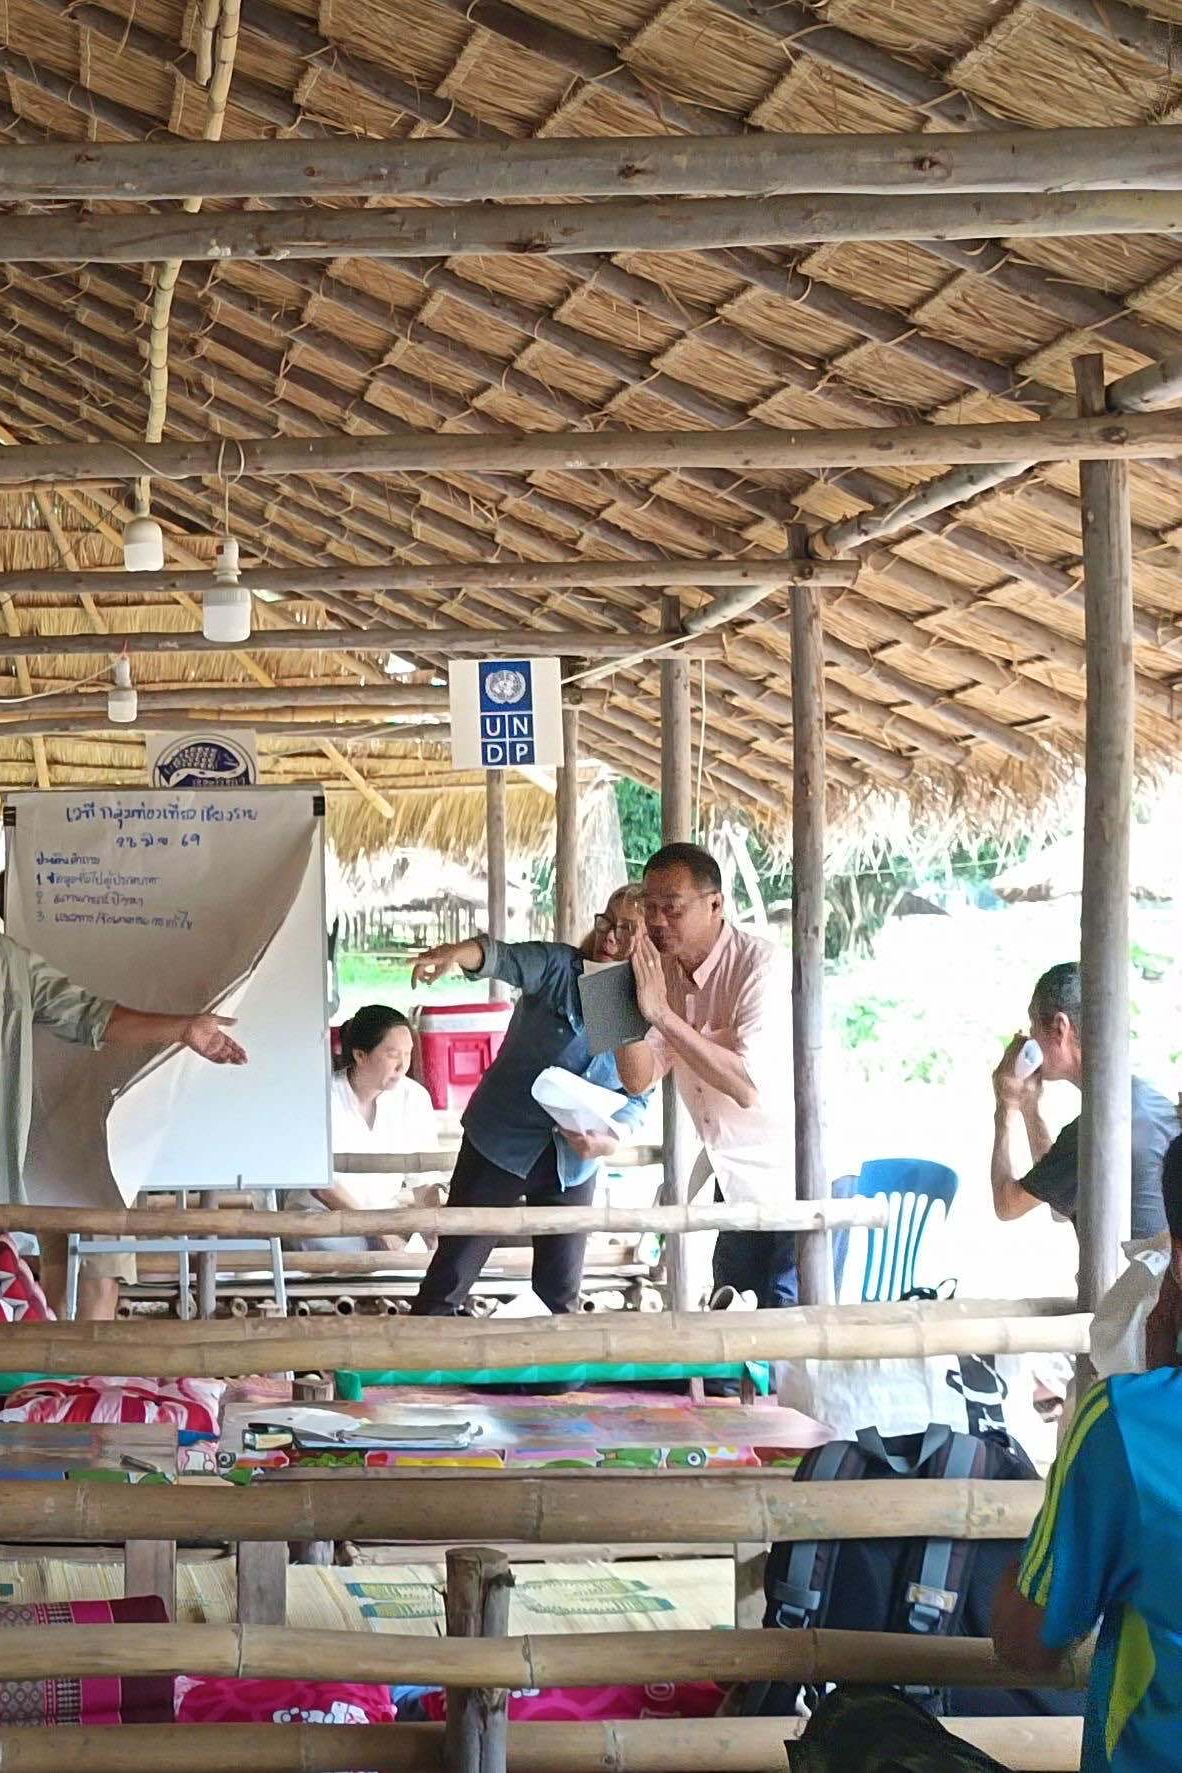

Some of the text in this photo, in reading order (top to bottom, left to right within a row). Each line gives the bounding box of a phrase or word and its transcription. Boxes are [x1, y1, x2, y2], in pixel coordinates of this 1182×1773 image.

[485, 716, 528, 737] UN
[486, 743, 528, 763] DP
[181, 832, 201, 848] 69
